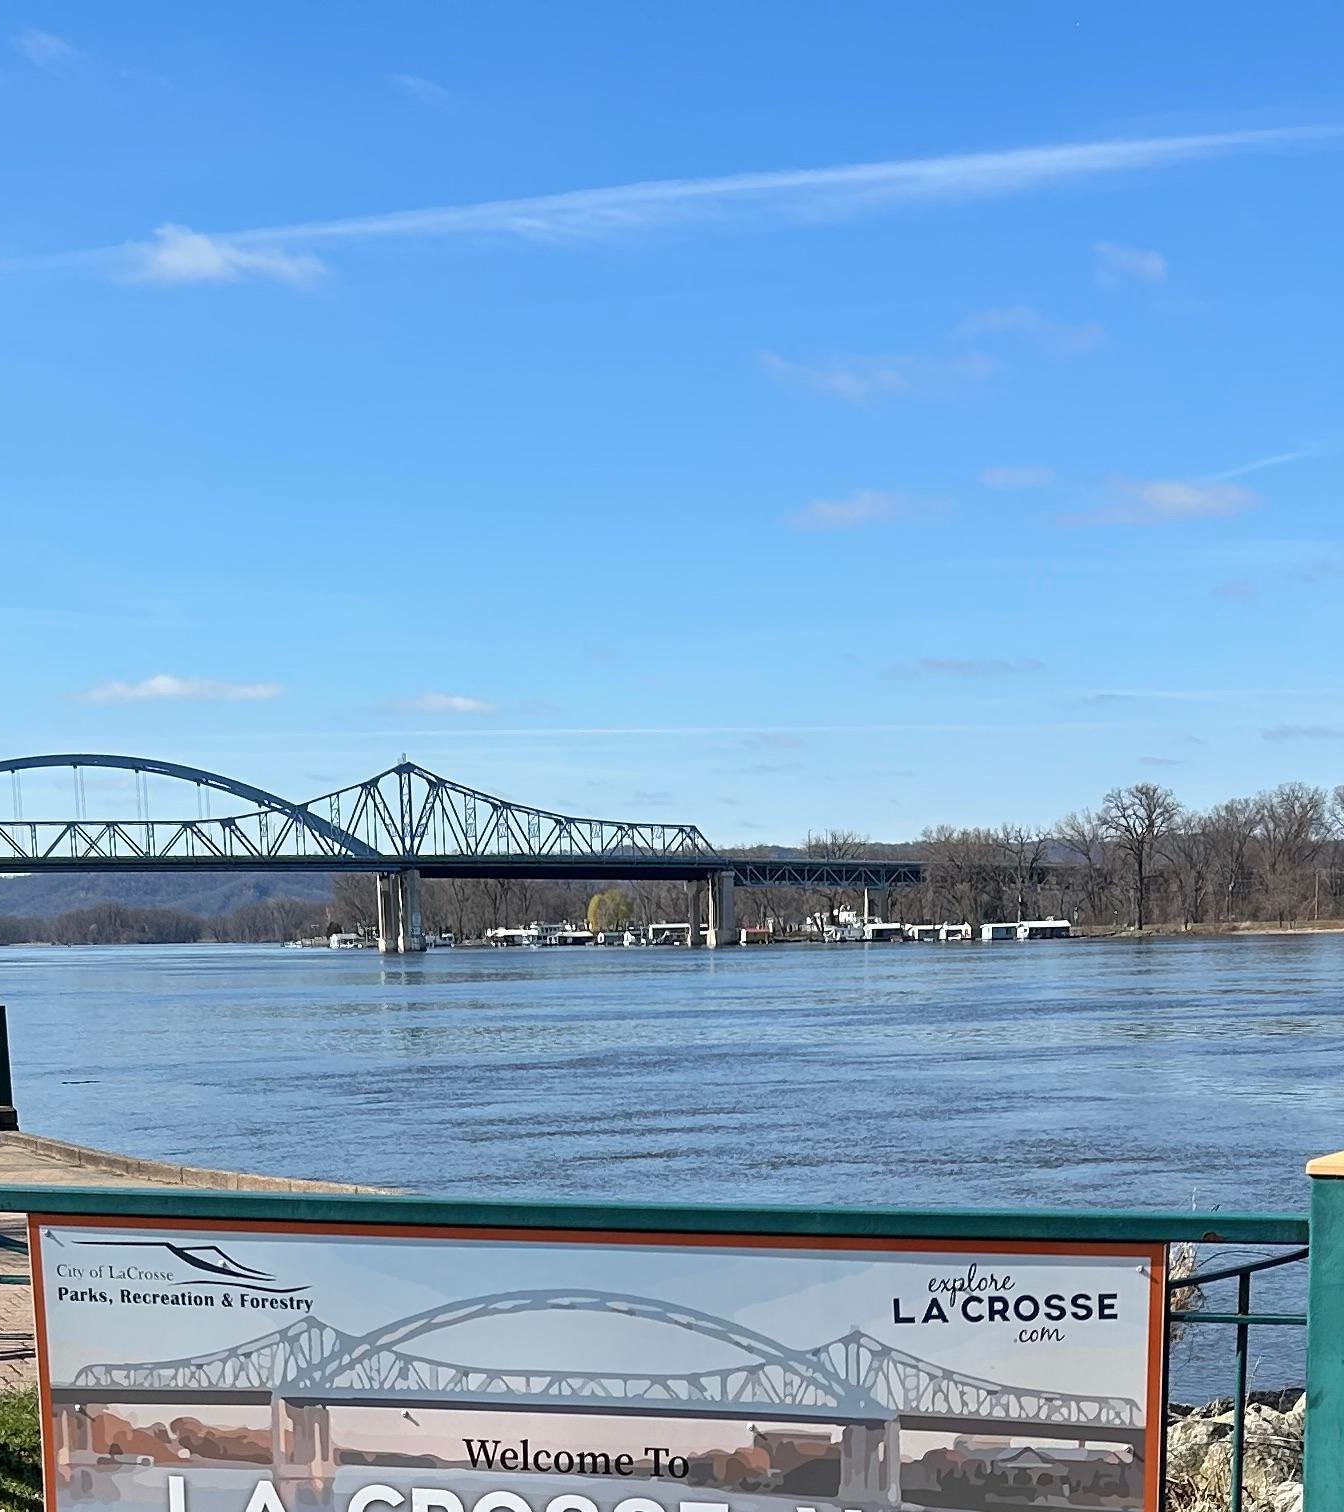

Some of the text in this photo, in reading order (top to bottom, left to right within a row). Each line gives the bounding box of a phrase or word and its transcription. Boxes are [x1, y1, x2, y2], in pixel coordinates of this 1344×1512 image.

[56, 1264, 174, 1282] City of LaCrosse
[928, 1263, 1015, 1308] explore
[58, 1287, 314, 1313] Parks, Recreation & Forestry
[893, 1293, 1119, 1325] LA CROSSE
[1013, 1326, 1065, 1343] .com
[462, 1438, 690, 1478] Welcome To
